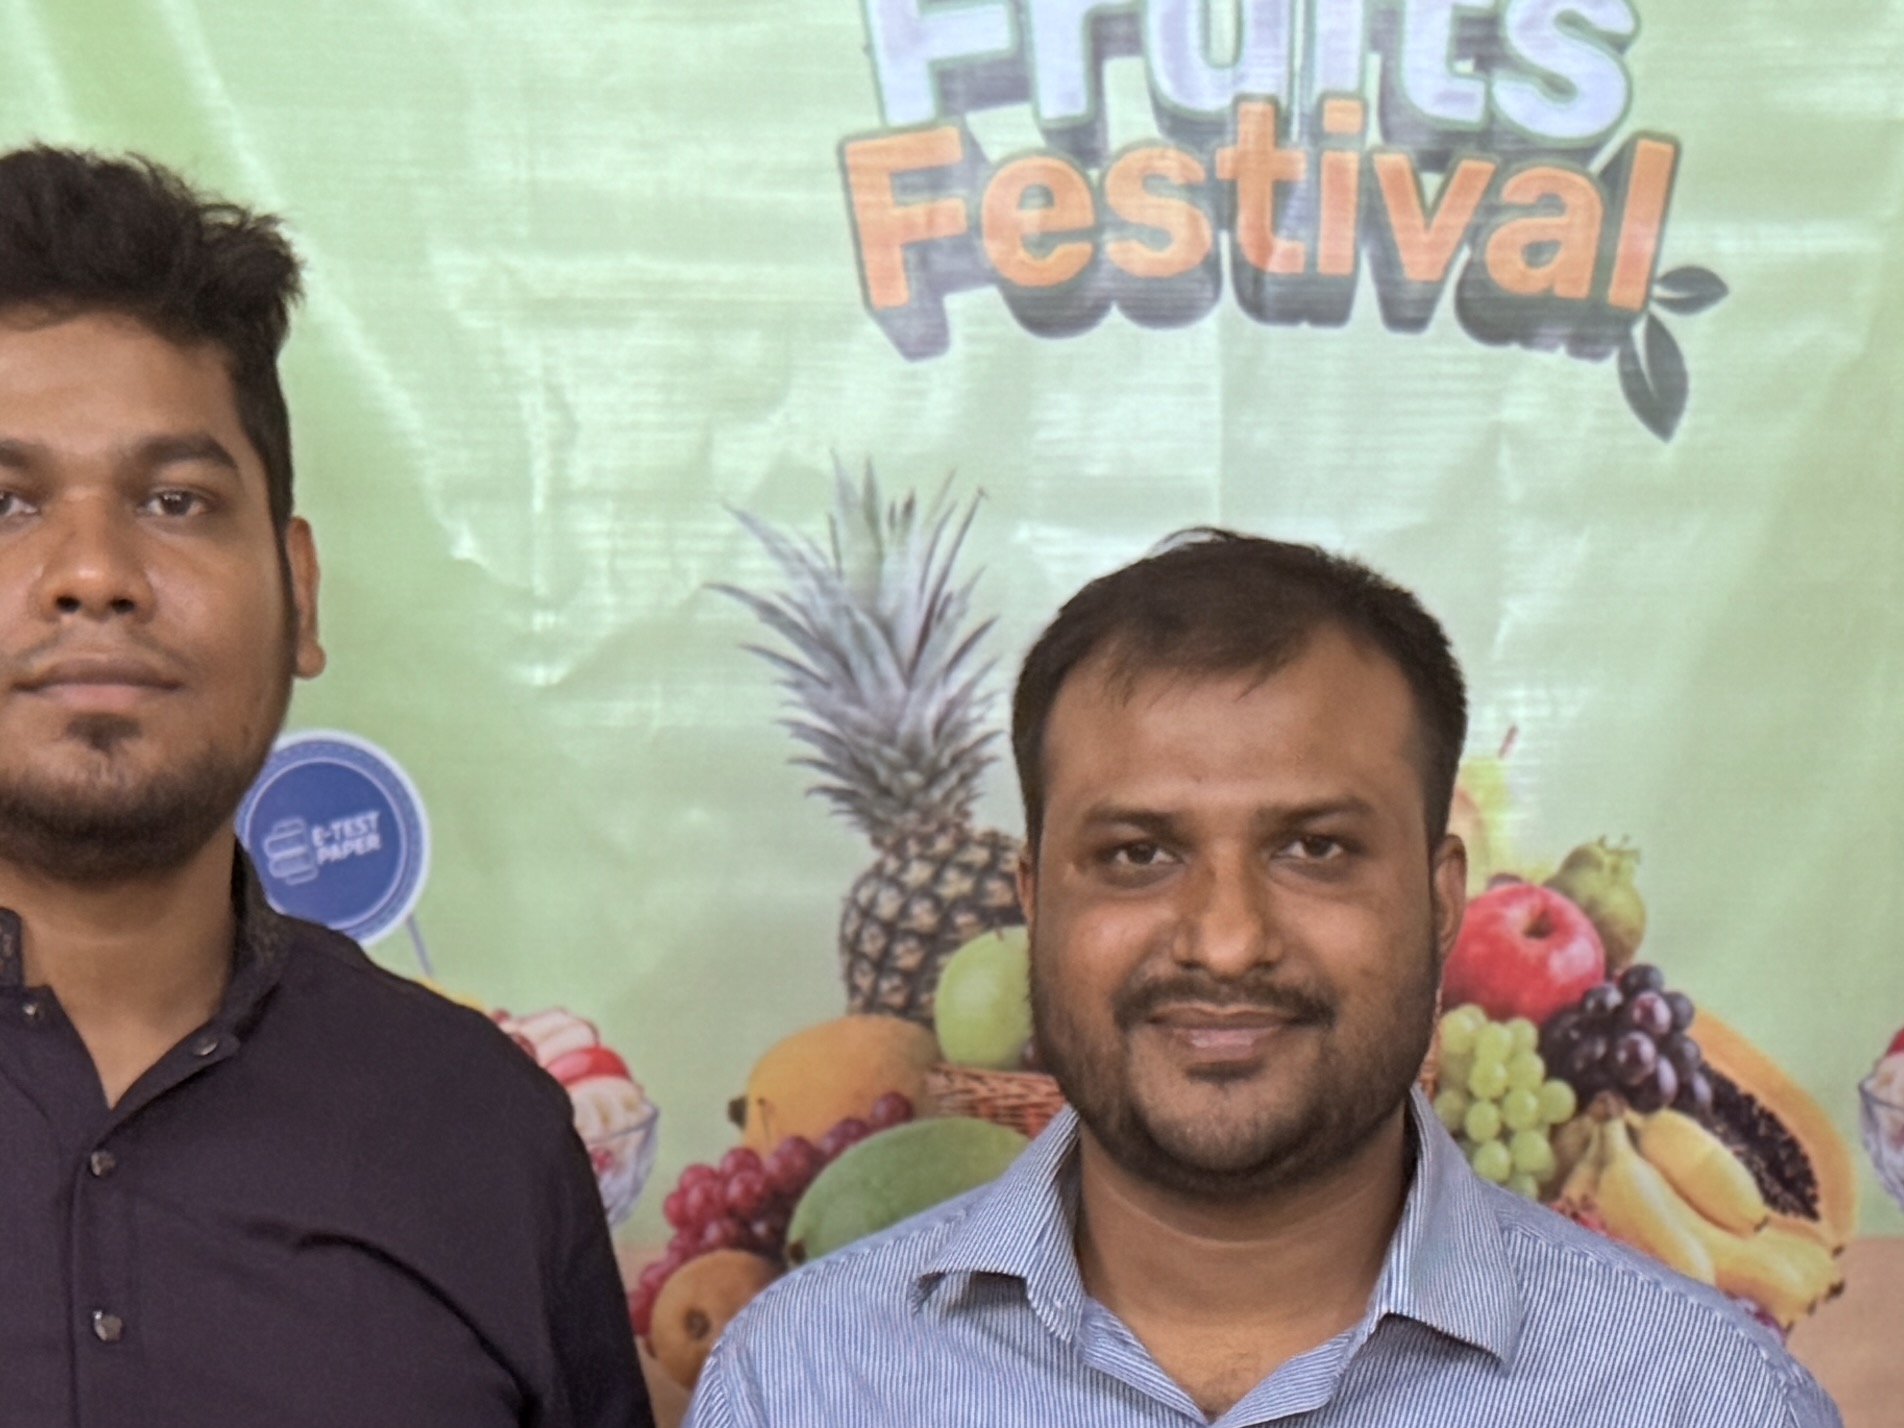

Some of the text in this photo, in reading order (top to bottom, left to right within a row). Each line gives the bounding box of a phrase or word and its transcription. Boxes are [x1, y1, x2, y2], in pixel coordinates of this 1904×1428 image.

[868, 0, 1641, 144] Fruits
[838, 92, 1678, 312] Festival
[312, 811, 380, 846] E-TEST
[316, 834, 381, 864] PAPER
